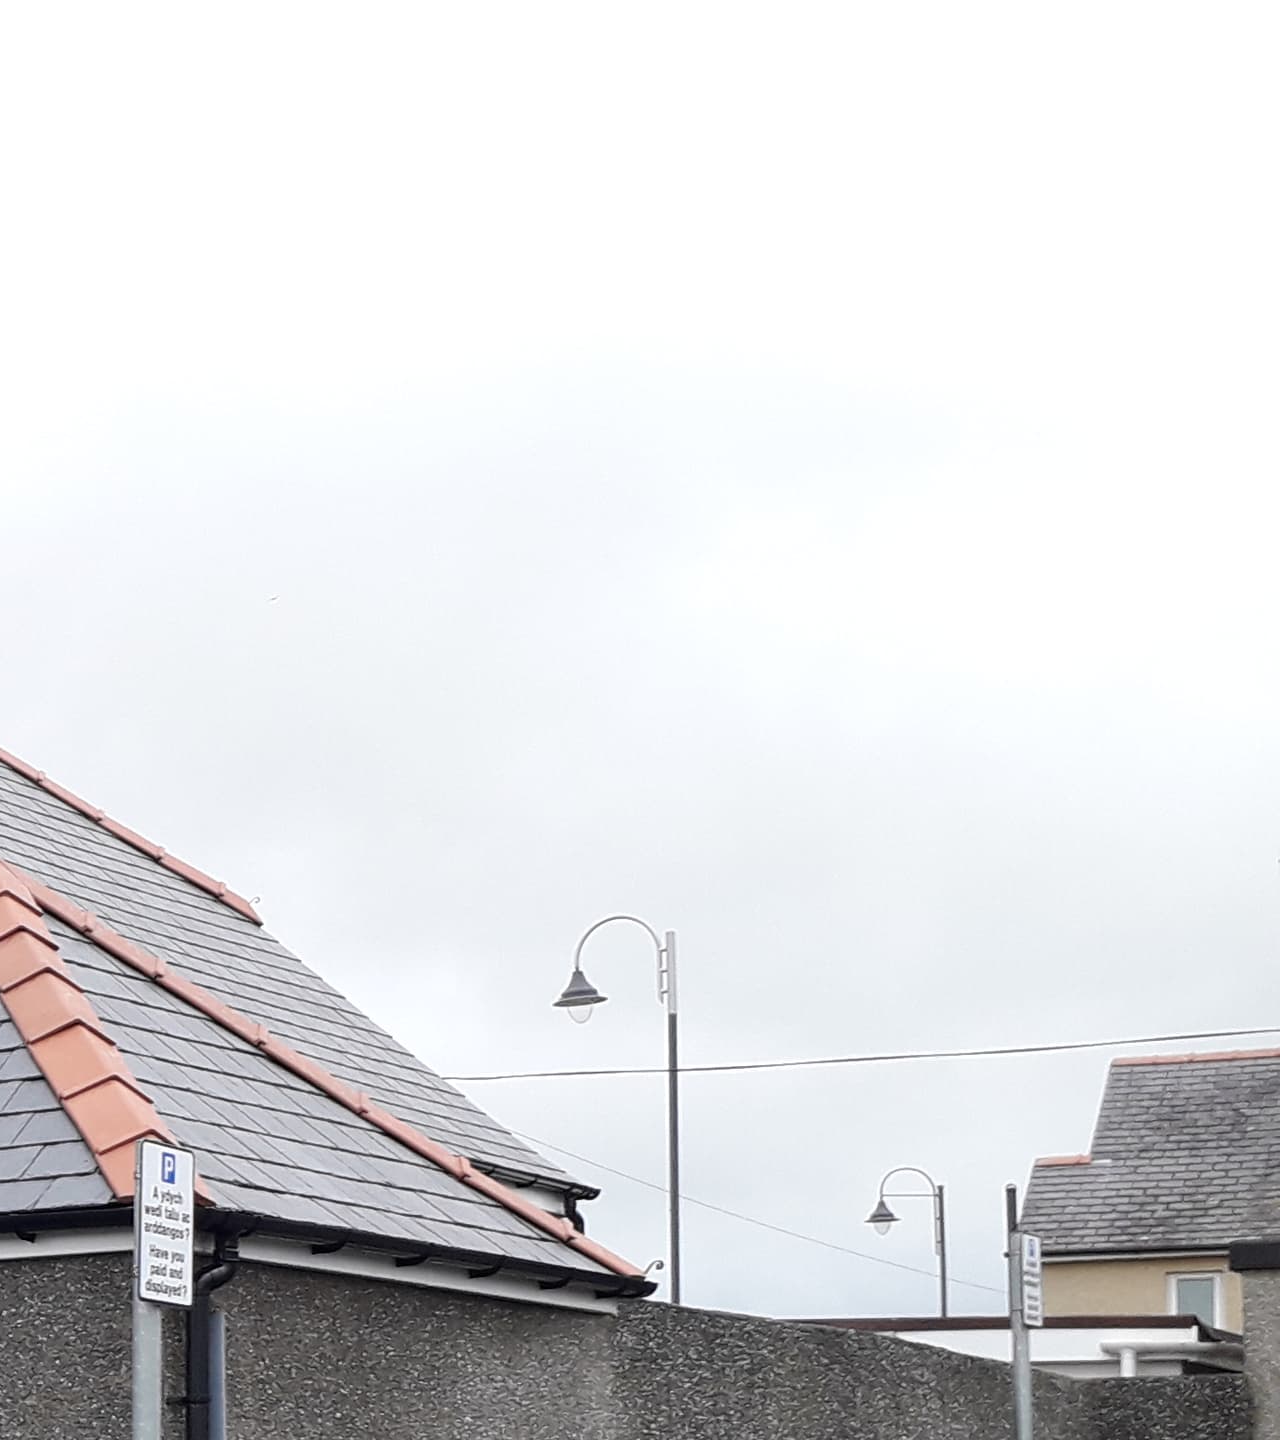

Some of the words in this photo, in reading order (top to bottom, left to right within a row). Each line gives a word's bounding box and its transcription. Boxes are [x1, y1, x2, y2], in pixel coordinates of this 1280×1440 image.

[164, 1155, 174, 1181] P
[153, 1186, 159, 1199] A
[160, 1189, 183, 1205] ydych
[144, 1205, 162, 1217] wedi
[182, 1213, 190, 1223] ac
[149, 1244, 168, 1260] Have
[171, 1251, 184, 1263] you
[150, 1263, 167, 1277] paid
[169, 1267, 182, 1279] and
[145, 1278, 187, 1297] displayed?
